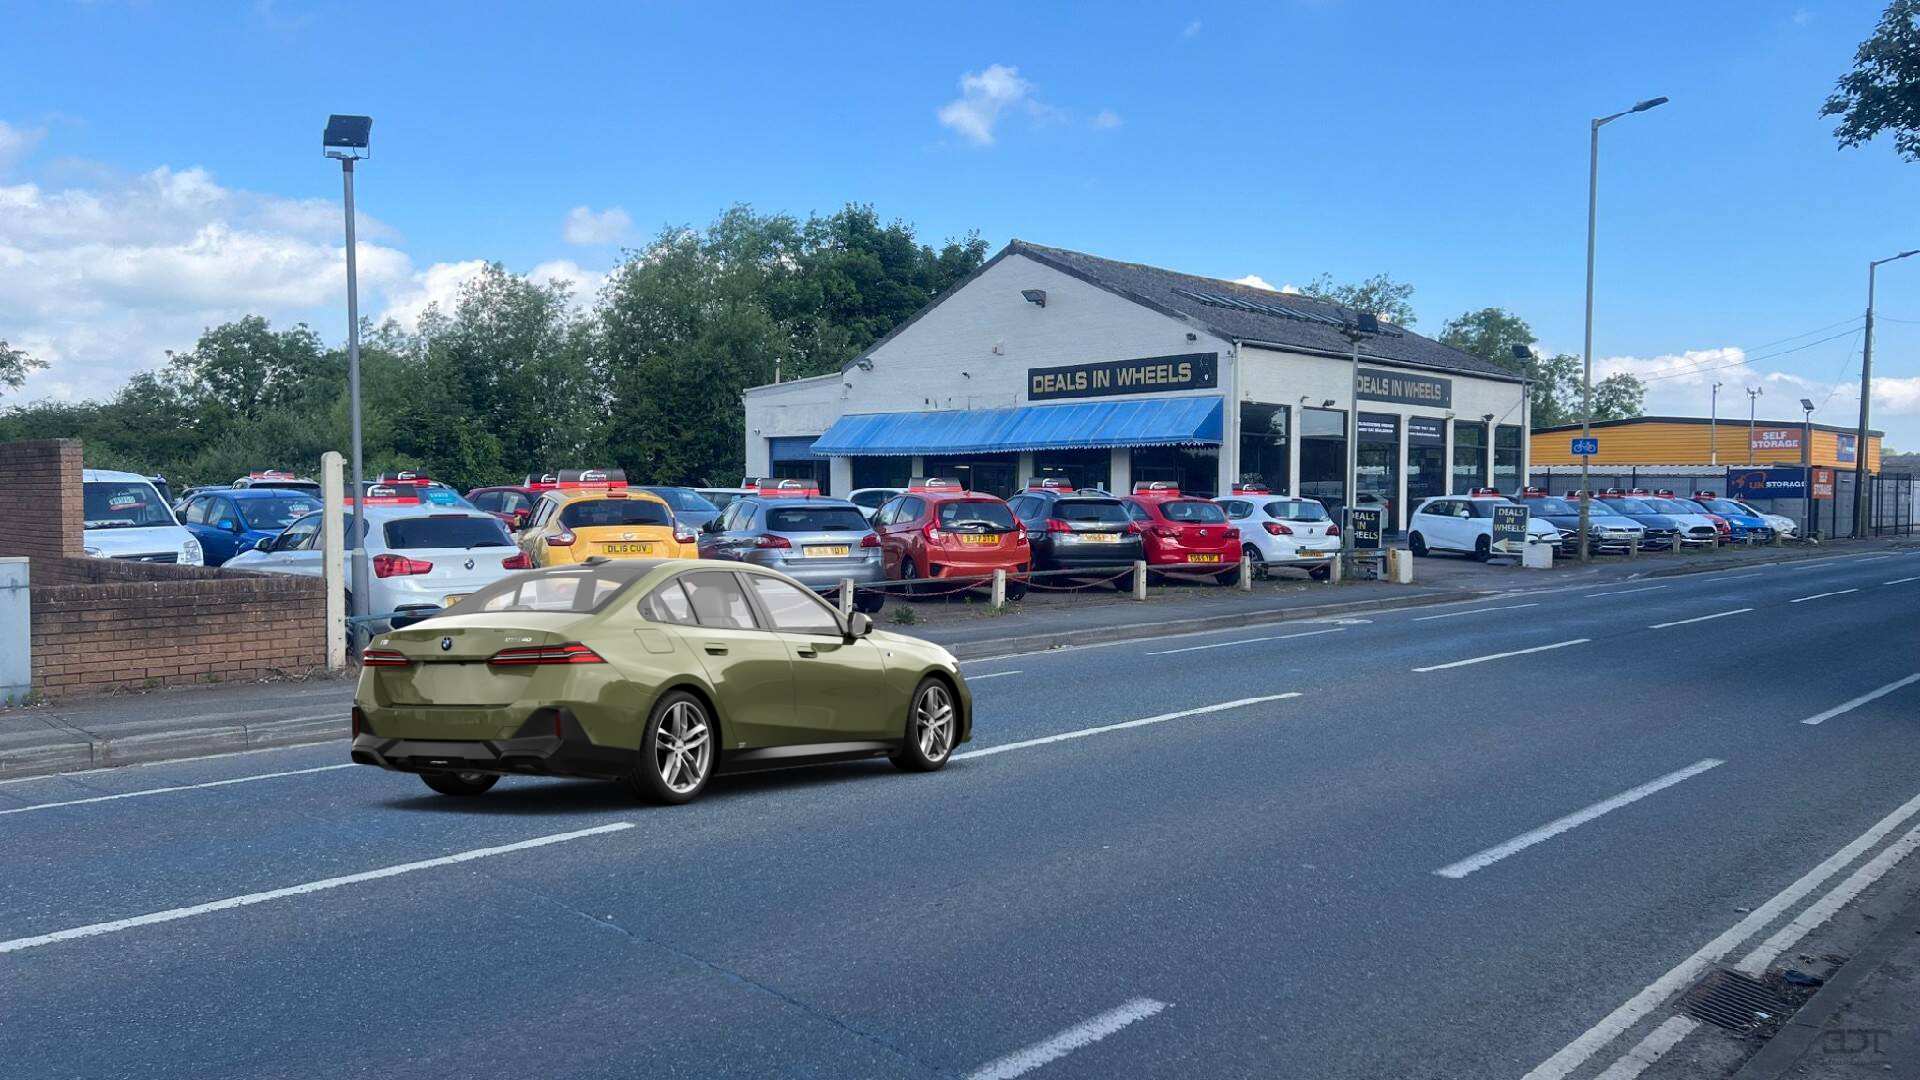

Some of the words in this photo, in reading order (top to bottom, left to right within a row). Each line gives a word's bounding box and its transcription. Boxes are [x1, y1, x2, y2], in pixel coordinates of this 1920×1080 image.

[1033, 371, 1087, 393] DEALS
[1093, 369, 1110, 388] IN
[1117, 362, 1192, 387] WHEELS
[1357, 376, 1389, 395] DEALS
[1392, 379, 1402, 397] IN
[1404, 381, 1441, 400] WHEELS
[1762, 431, 1787, 440] SELF
[1752, 440, 1799, 448] STORAGE
[1498, 508, 1524, 517] DEALS
[1494, 524, 1526, 532] WHEELS
